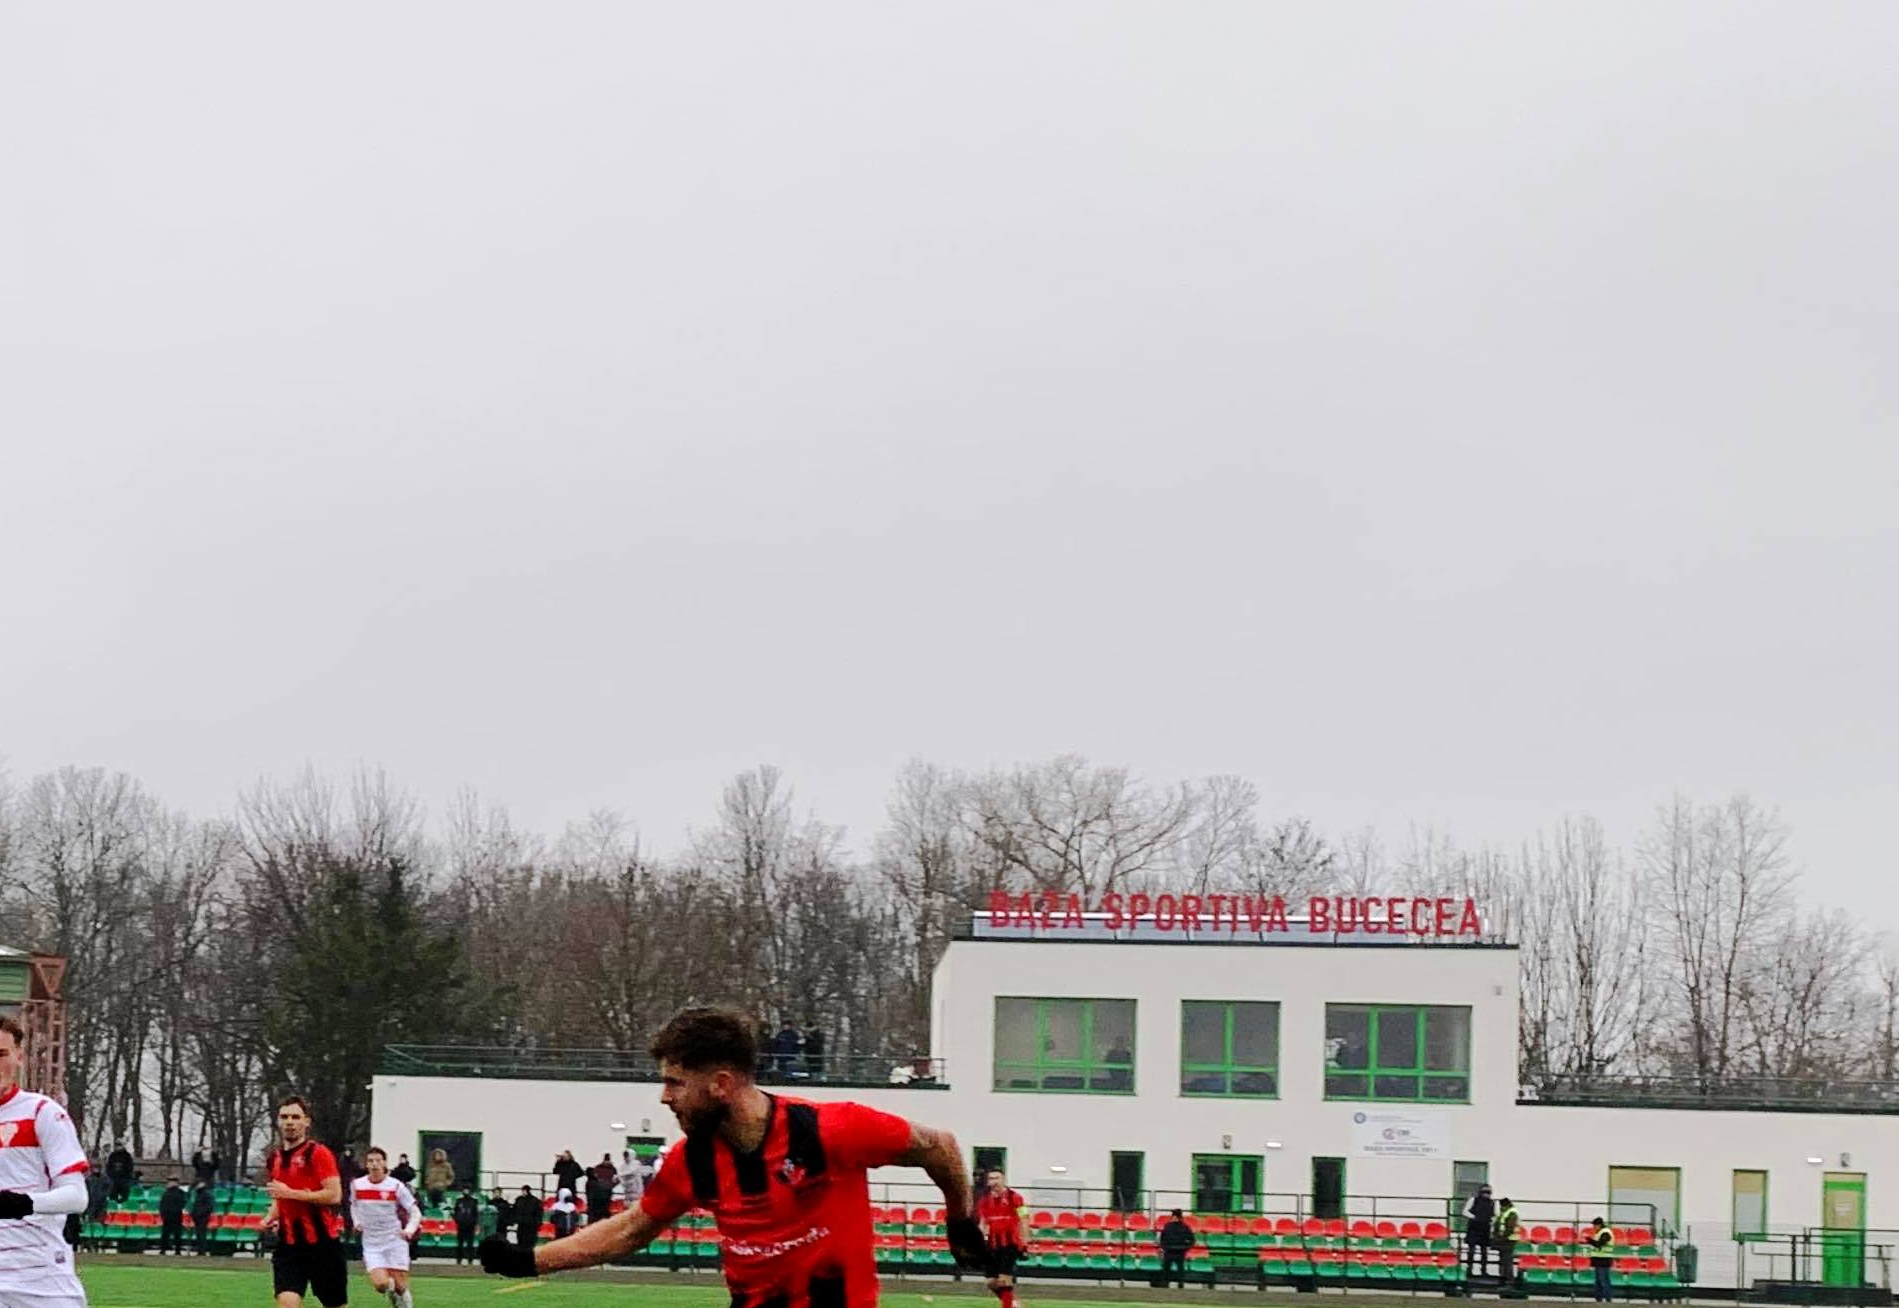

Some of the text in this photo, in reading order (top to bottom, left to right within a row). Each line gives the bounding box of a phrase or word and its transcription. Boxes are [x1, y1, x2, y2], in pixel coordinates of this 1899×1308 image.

[989, 889, 1481, 936] BAZA SPORTIVA BUCECEA
